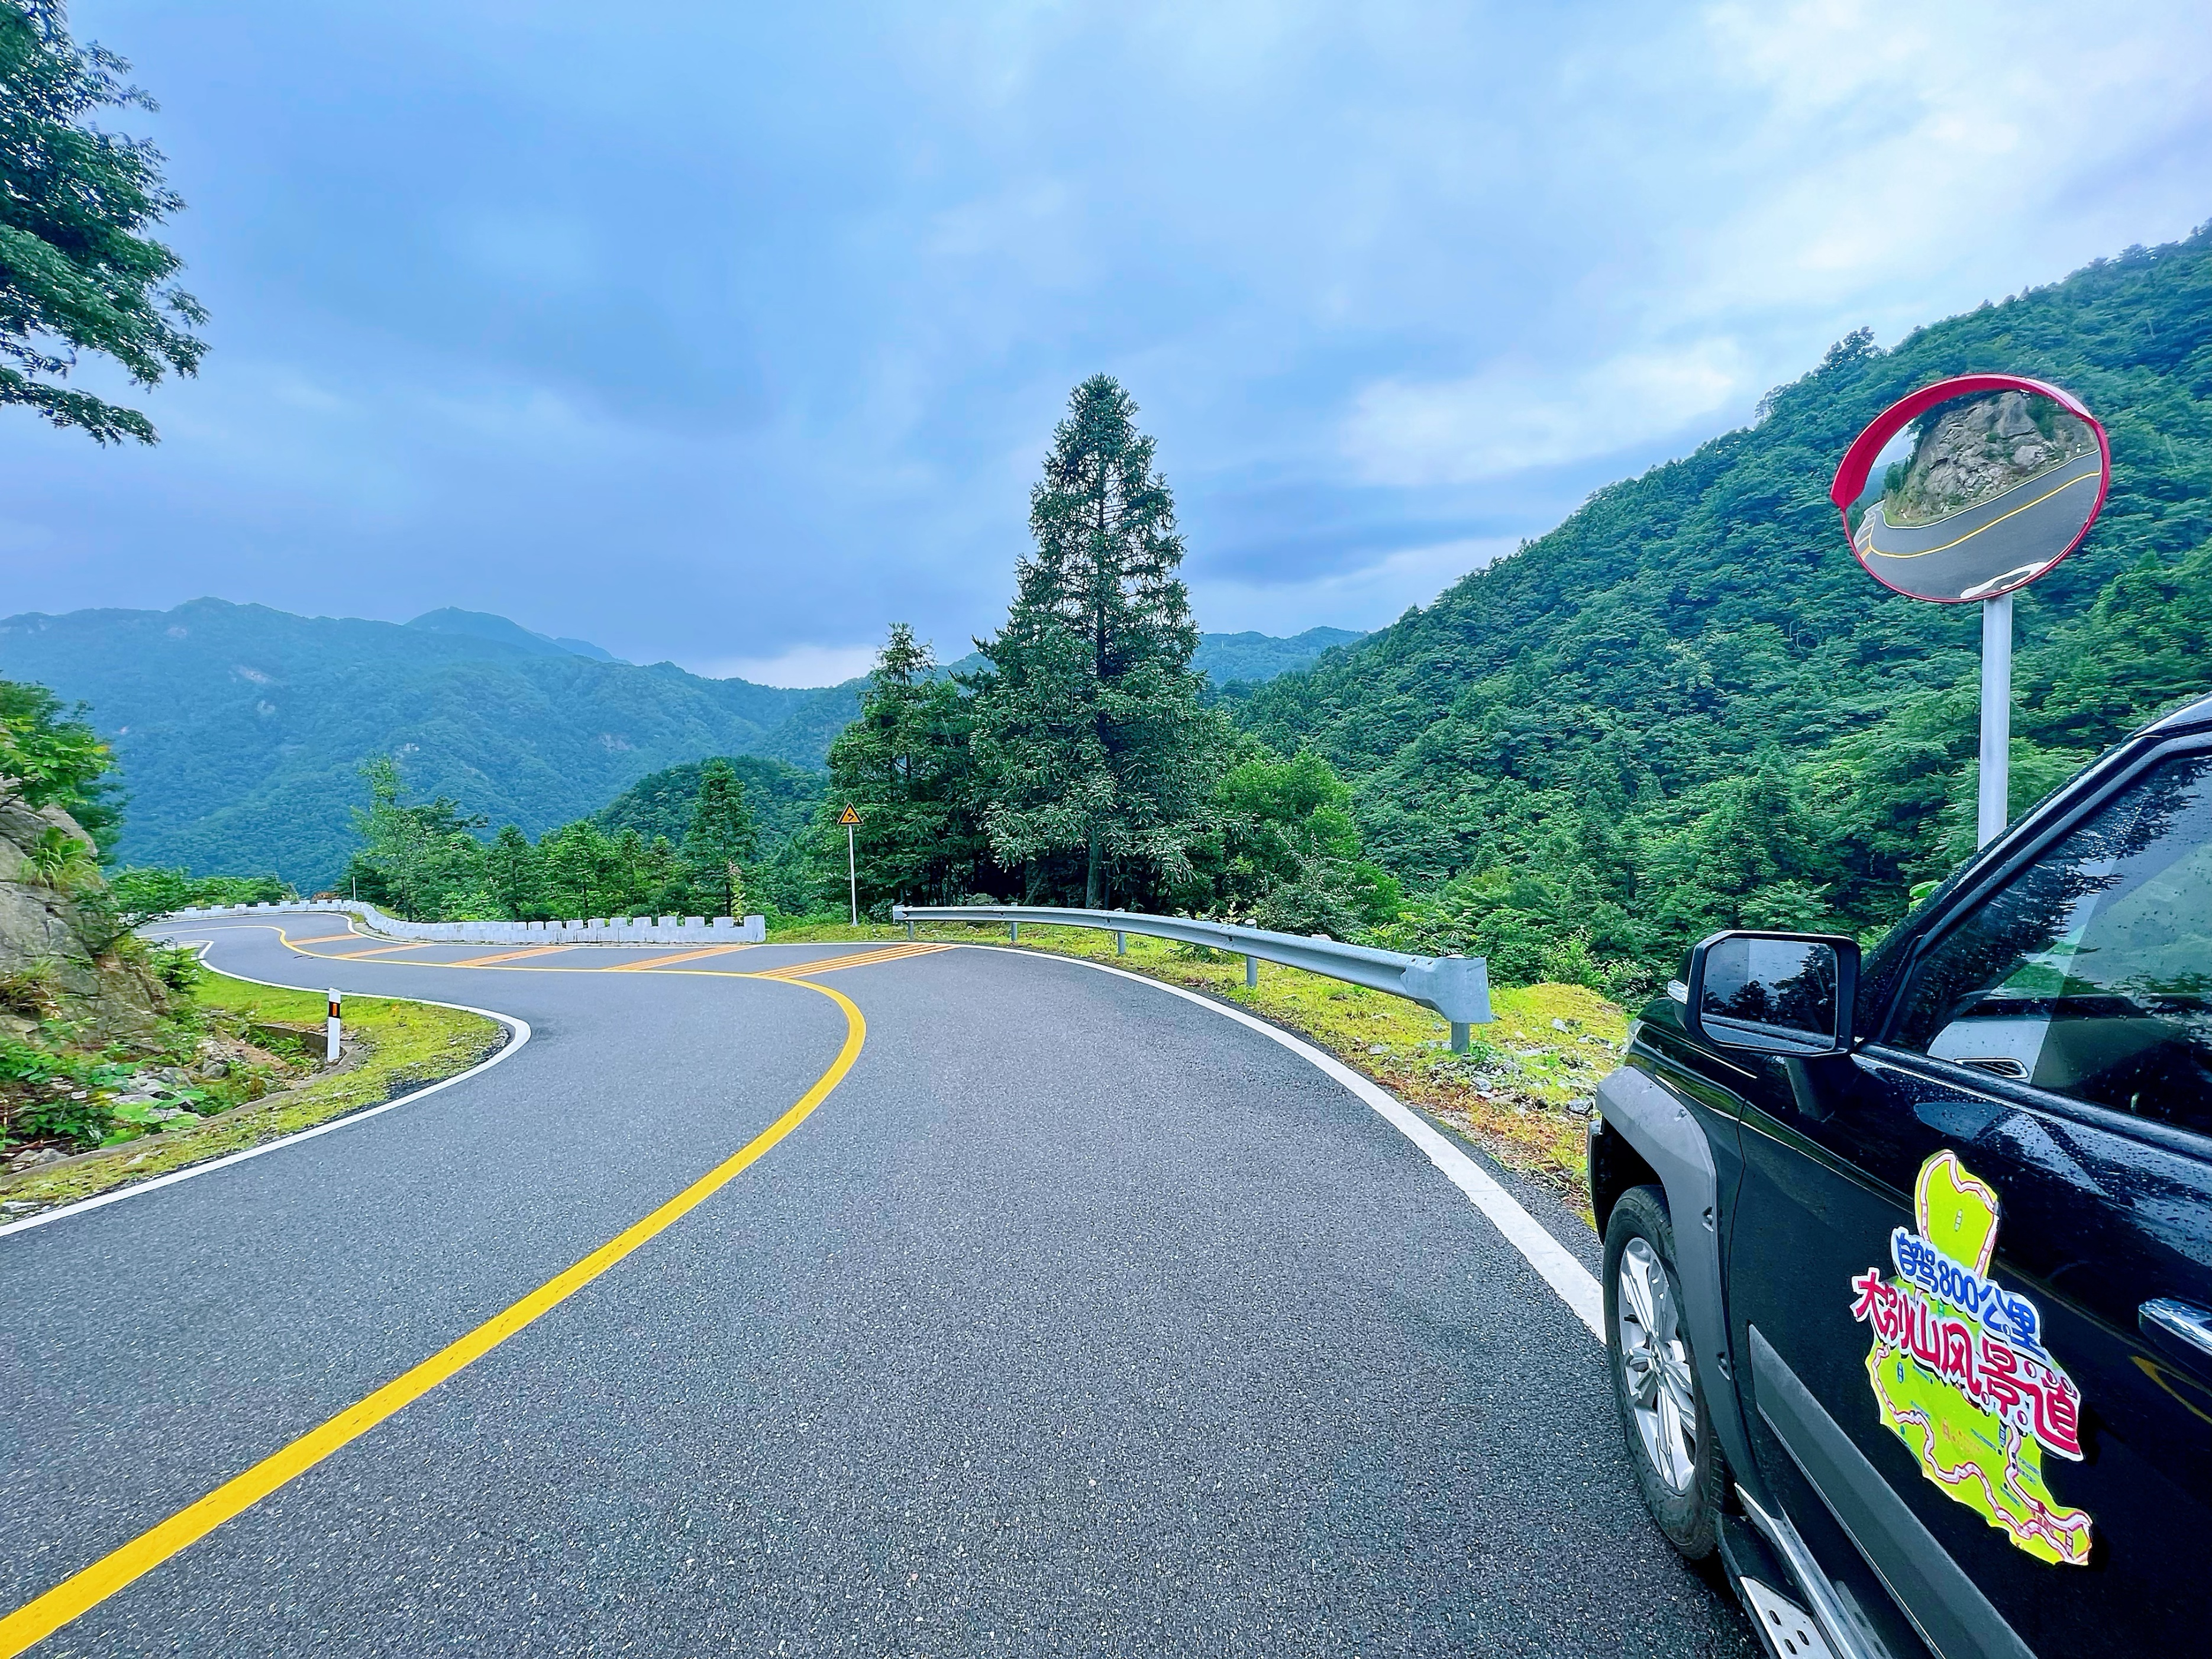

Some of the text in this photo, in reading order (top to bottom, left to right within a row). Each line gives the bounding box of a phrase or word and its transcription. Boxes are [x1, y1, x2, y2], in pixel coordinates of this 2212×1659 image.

[1856, 1271, 2081, 1455] 大别山风景道
[1896, 1232, 2047, 1361] 自驾800公里
